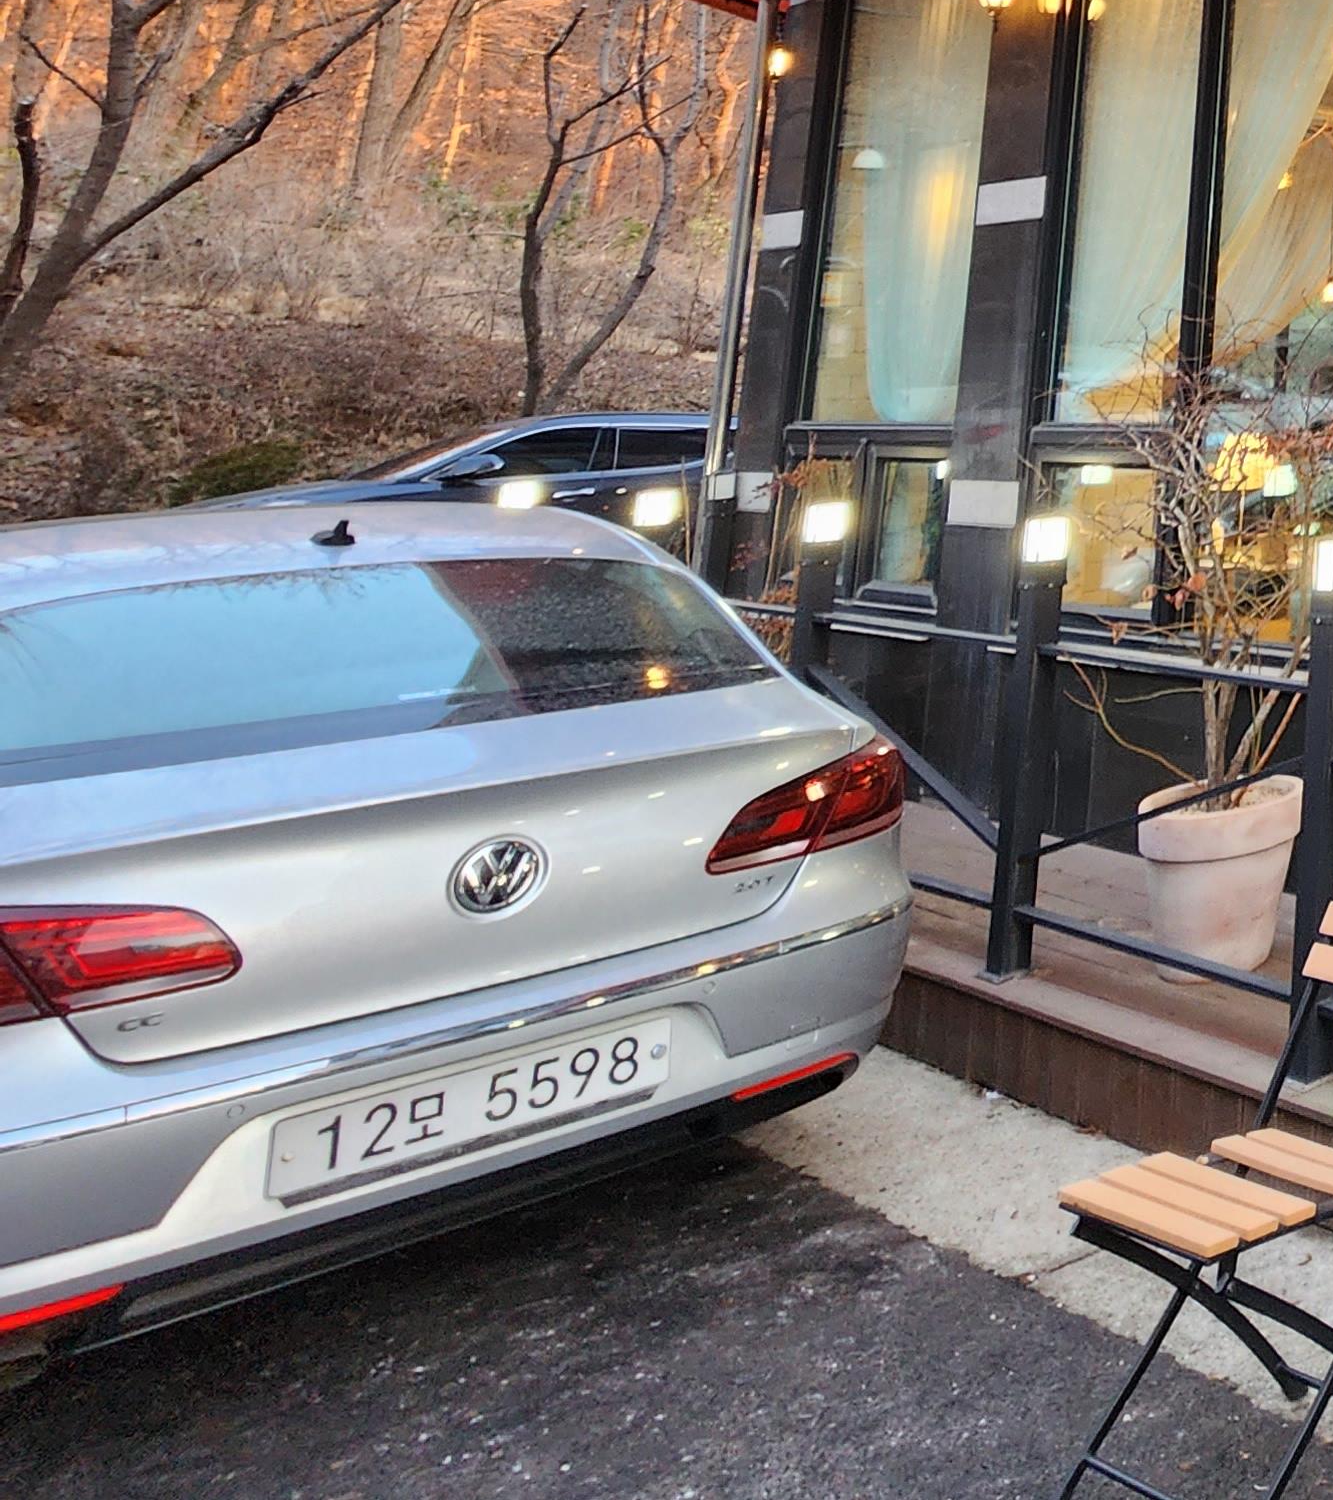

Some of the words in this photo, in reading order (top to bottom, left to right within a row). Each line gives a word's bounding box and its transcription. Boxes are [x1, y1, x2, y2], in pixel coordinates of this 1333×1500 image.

[117, 1012, 165, 1032] CC
[317, 1092, 446, 1169] 12모
[485, 1036, 640, 1122] 5598
